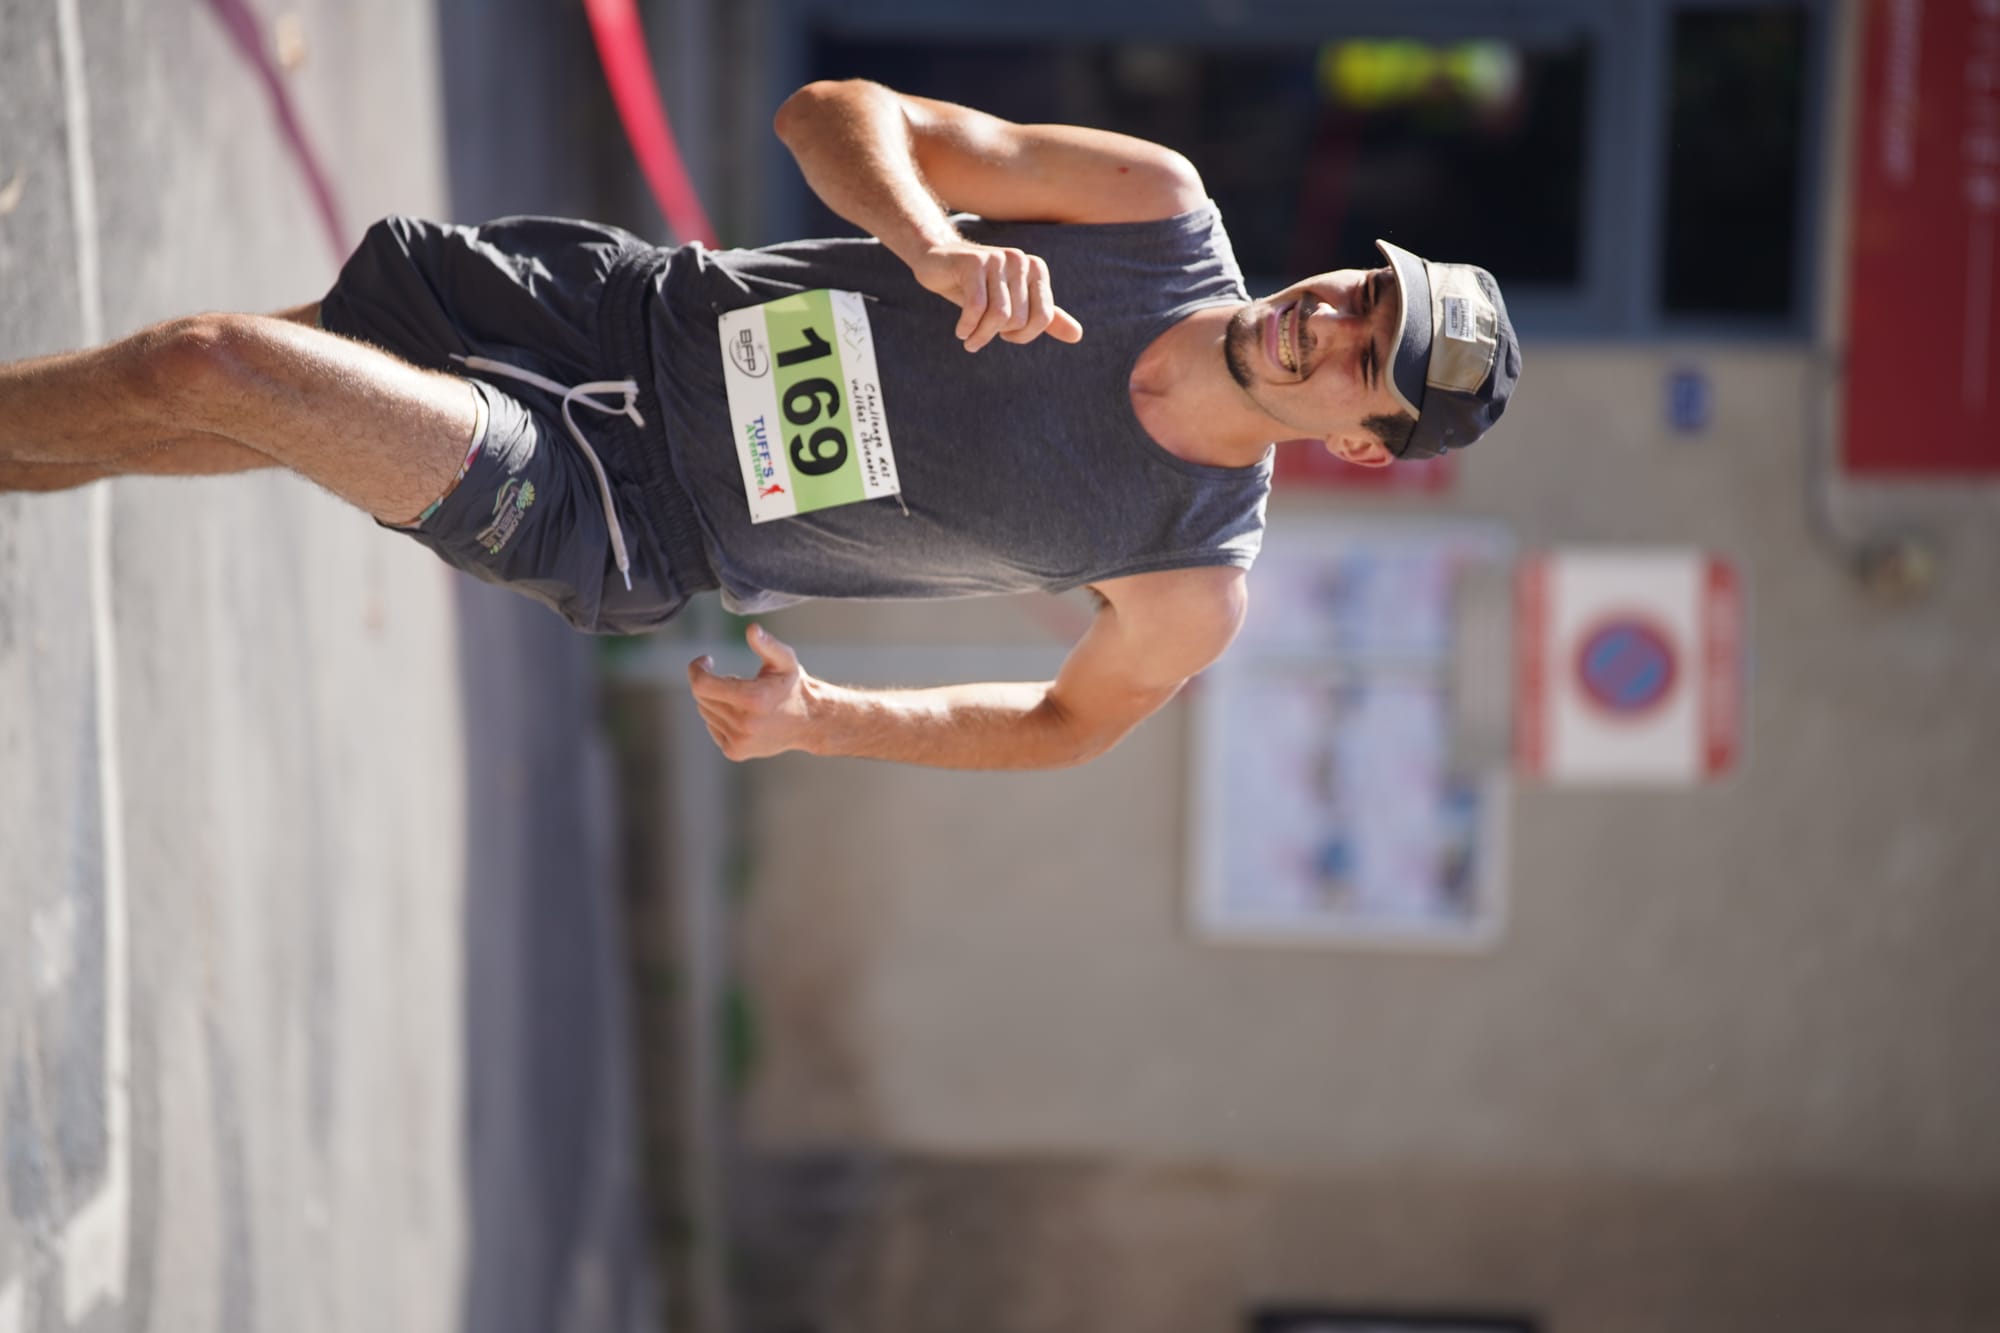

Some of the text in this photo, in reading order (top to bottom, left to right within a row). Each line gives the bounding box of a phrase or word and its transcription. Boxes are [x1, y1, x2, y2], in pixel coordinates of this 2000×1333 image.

[739, 328, 757, 372] BFP
[776, 327, 848, 476] 169
[862, 383, 891, 478] Challenge des
[745, 424, 764, 486] Aventure
[752, 415, 774, 478] TUFF'S
